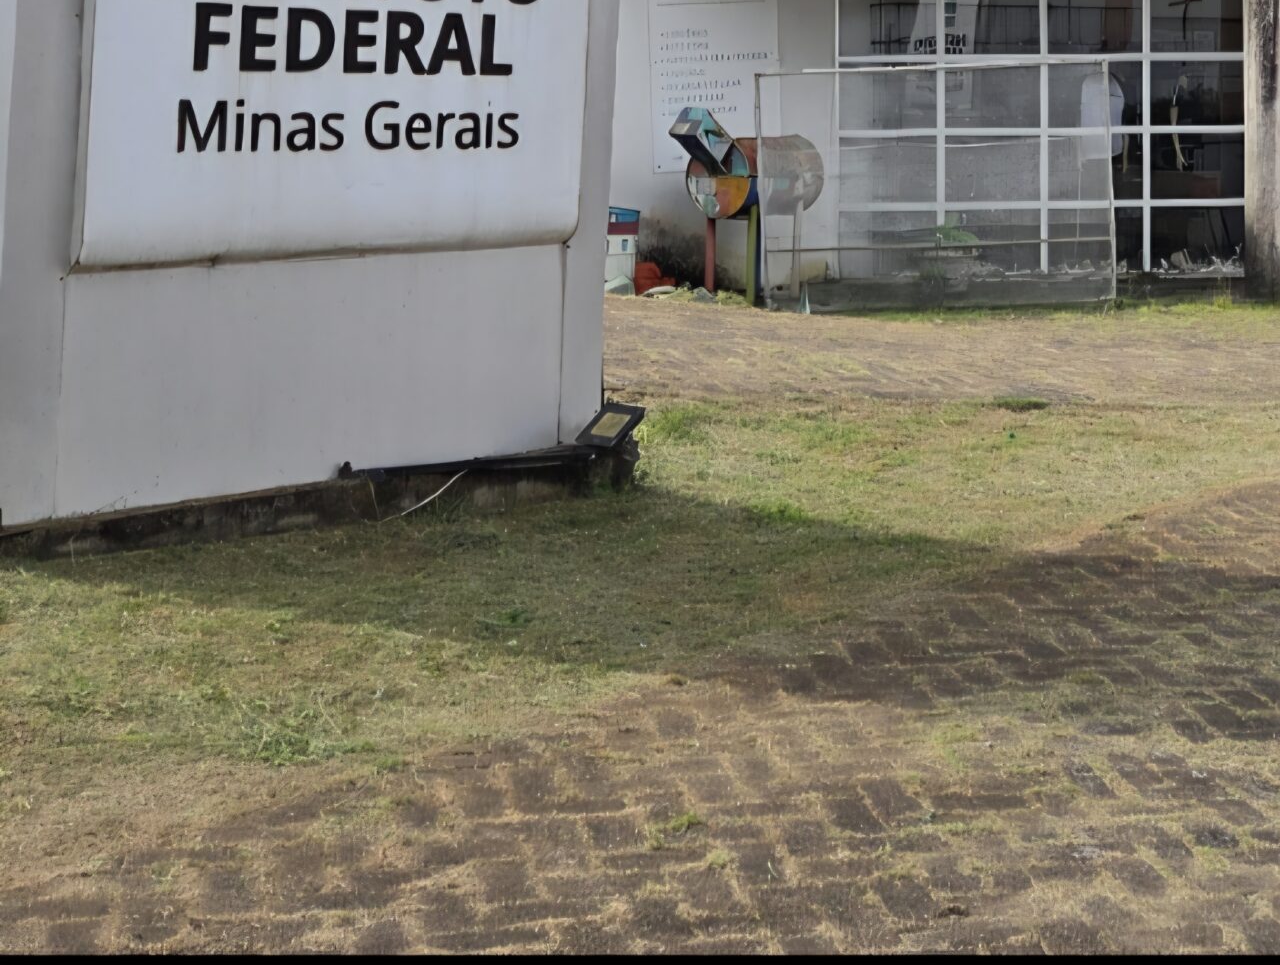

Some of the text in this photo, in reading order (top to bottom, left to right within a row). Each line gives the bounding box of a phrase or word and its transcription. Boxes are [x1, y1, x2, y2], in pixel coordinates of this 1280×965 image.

[193, 2, 513, 76] FEDERAL
[177, 98, 520, 153] Minas Gerais
